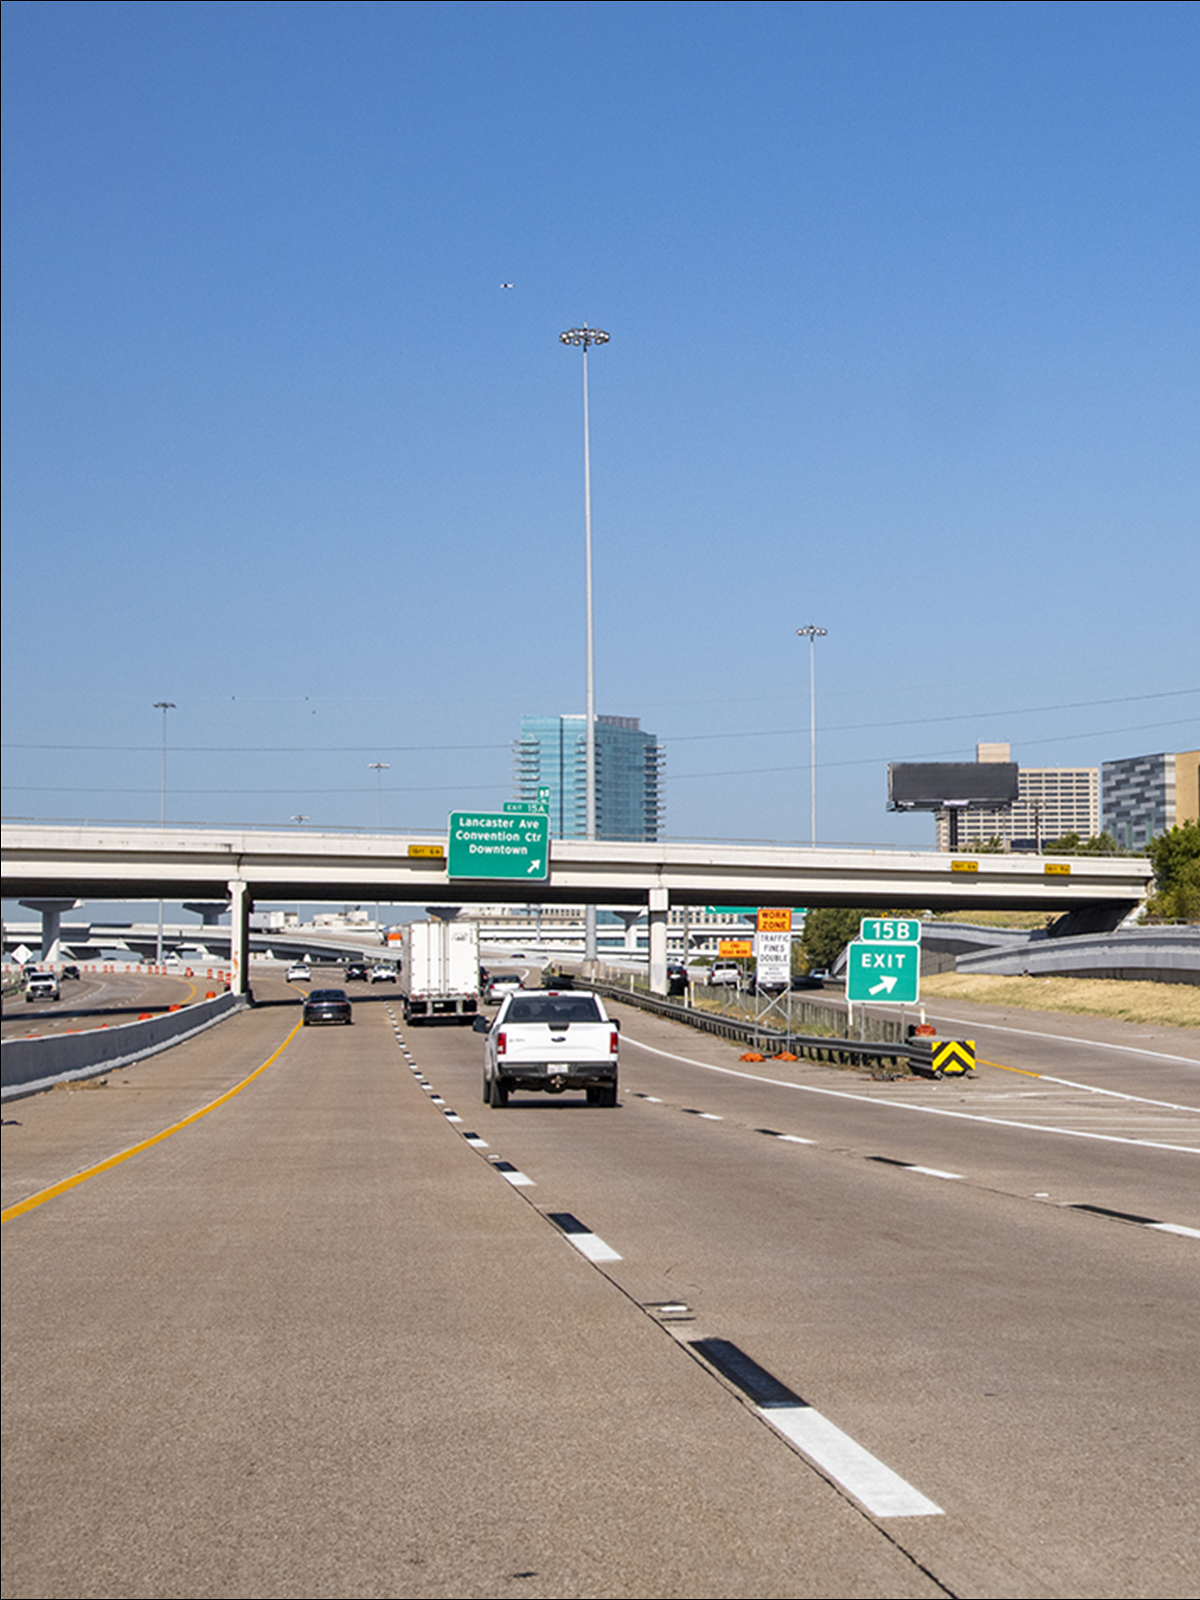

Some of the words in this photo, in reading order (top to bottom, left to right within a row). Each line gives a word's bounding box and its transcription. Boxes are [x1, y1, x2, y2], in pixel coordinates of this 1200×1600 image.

[459, 817, 514, 828] Lancaster
[518, 819, 540, 829] Ave
[455, 830, 520, 841] Convention
[524, 832, 542, 842] Ctr
[469, 844, 528, 855] Downtown
[762, 921, 787, 929] ZONE
[872, 921, 910, 939] 15B
[760, 934, 789, 943] TRAFFIC
[763, 944, 786, 953] FINES
[760, 953, 788, 962] DOUBLE
[861, 953, 906, 968] EXIT
